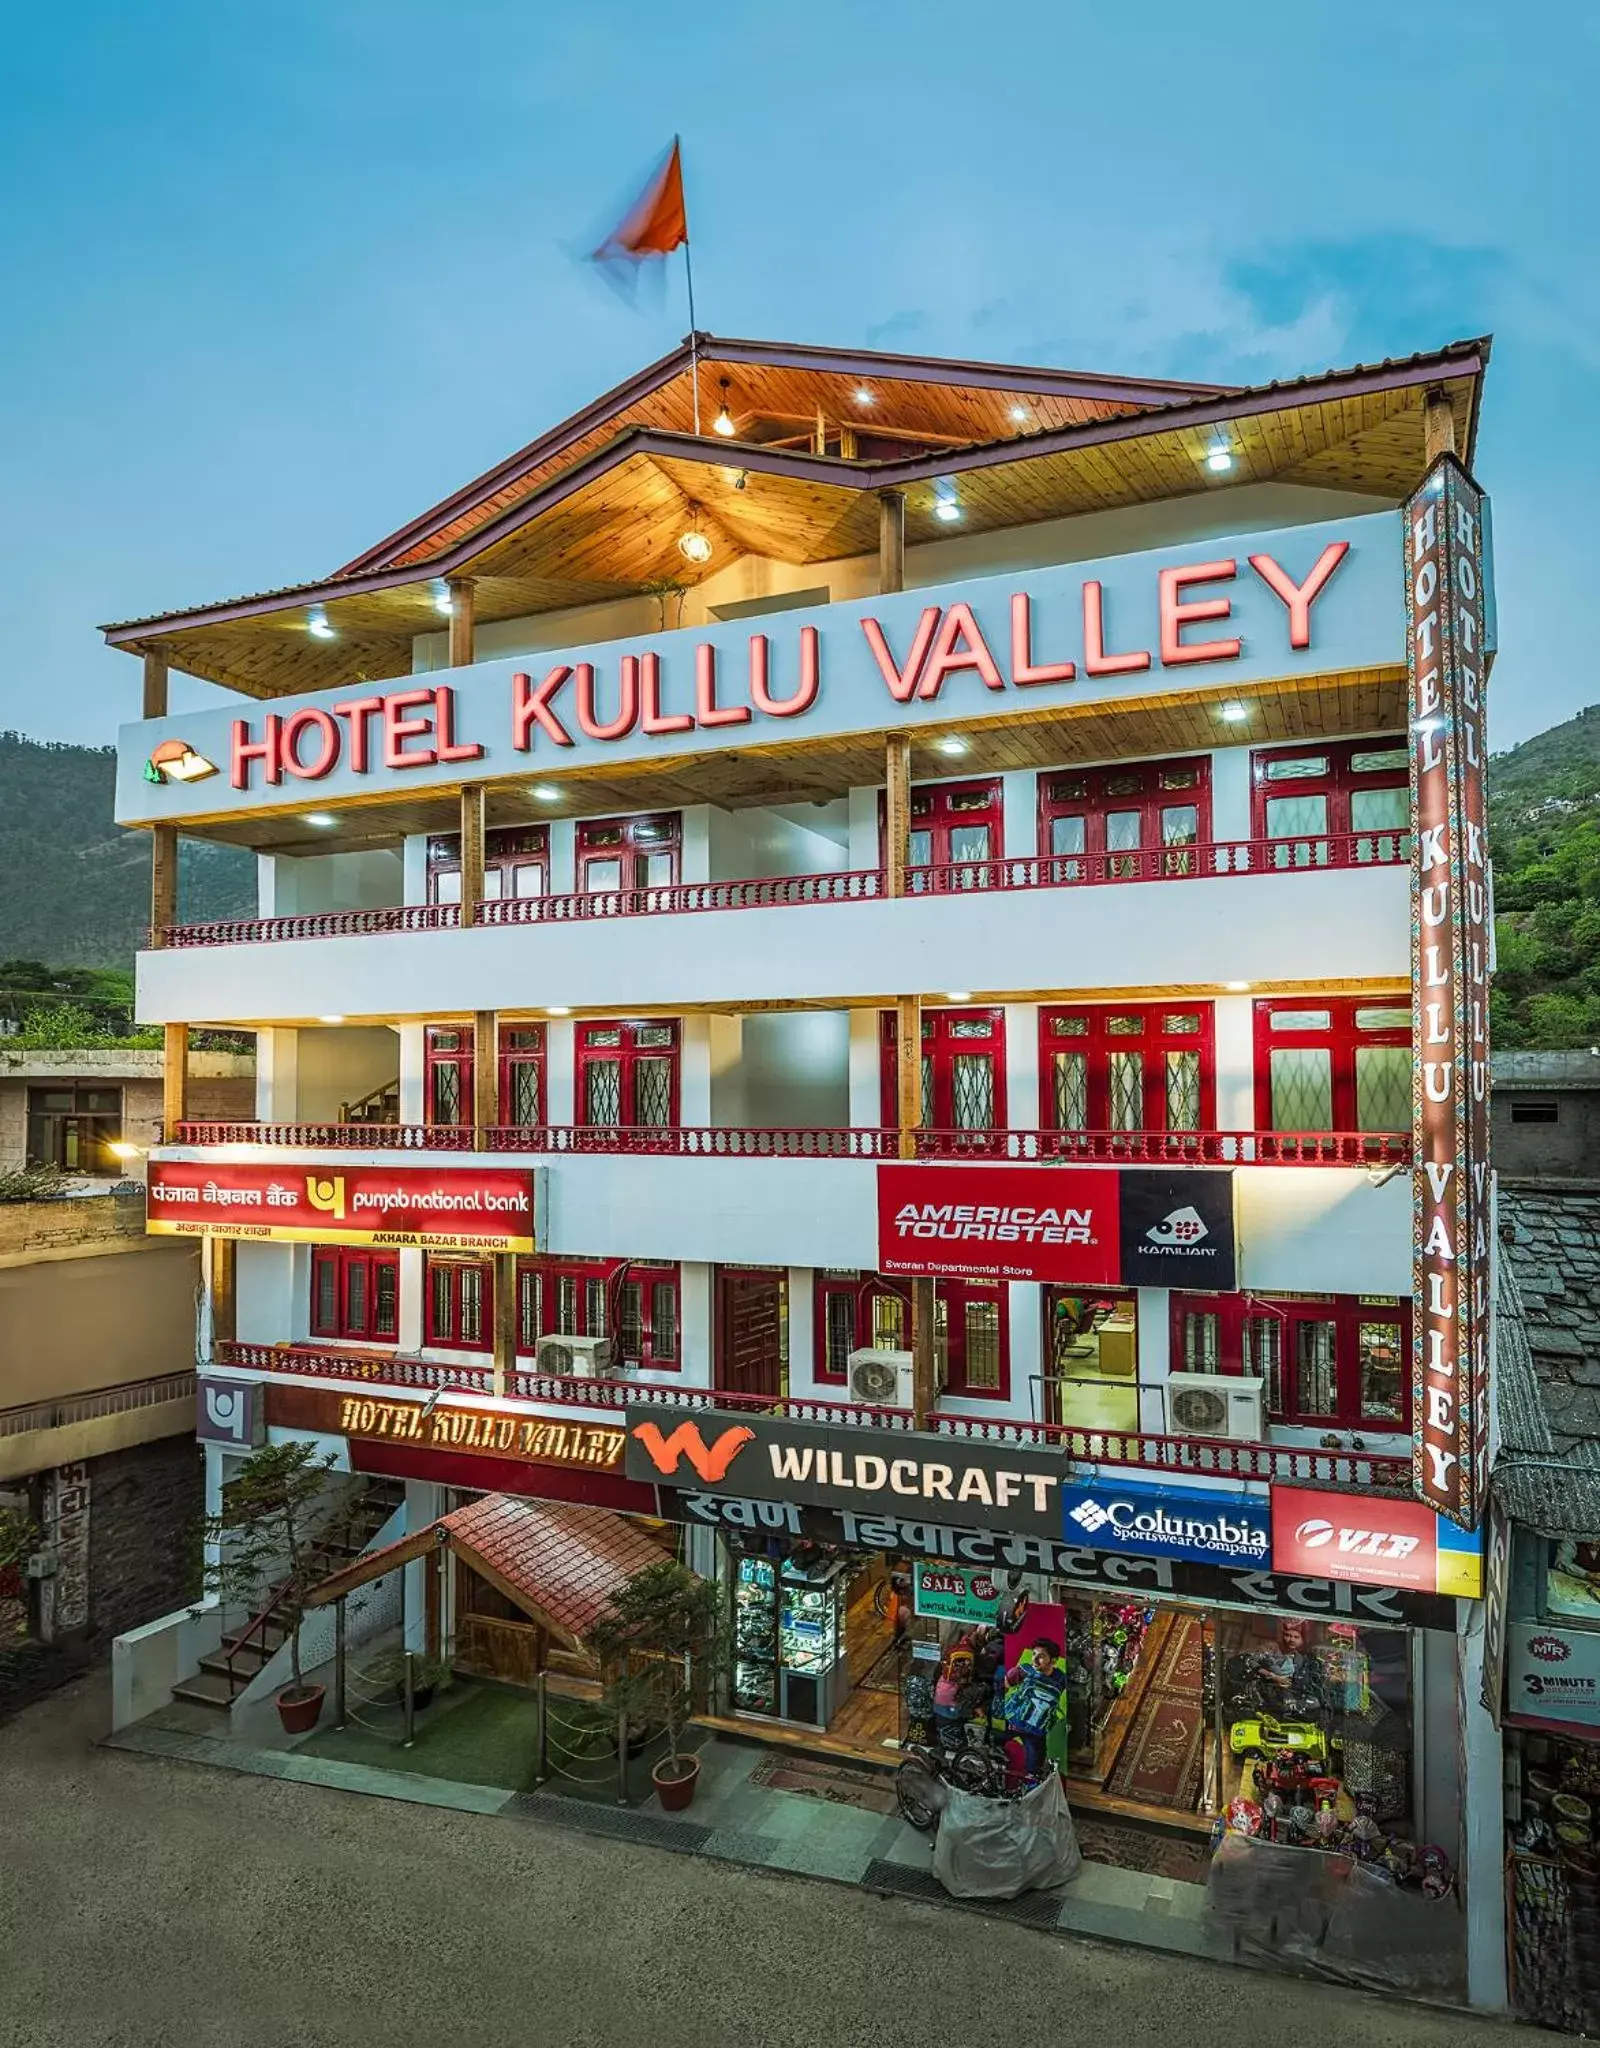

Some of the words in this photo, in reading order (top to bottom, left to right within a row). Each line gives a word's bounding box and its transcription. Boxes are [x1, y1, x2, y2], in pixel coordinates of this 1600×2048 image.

[1414, 504, 1442, 773] HOTEL
[1456, 501, 1480, 771] HOTEL
[230, 686, 484, 790] HOTEL
[512, 626, 819, 753] KULLU
[860, 541, 1350, 703] VALLEY
[1420, 823, 1452, 1104] KULLU
[1467, 820, 1486, 1103] KULLU
[151, 1181, 199, 1203] पंजाब
[202, 1180, 262, 1206] नैशनल
[265, 1182, 299, 1207] बैंक
[353, 1188, 409, 1213] punjab
[411, 1189, 482, 1210] national
[484, 1190, 529, 1212] bank
[895, 1203, 1093, 1226] AMERICAN
[372, 1233, 418, 1245] AKHARA
[420, 1235, 458, 1246] BAZAR
[461, 1236, 509, 1248] BRANCH
[927, 1262, 999, 1275] Departmental
[1002, 1266, 1033, 1276] Store
[1423, 1161, 1457, 1492] VALLEY
[341, 1398, 424, 1438] HOTEL
[768, 1443, 1058, 1513] WILDCRAFT
[1106, 1501, 1269, 1548] Columbia
[1112, 1526, 1193, 1548] Sportswear
[1194, 1535, 1267, 1560] Company
[922, 1576, 966, 1595] SALE
[976, 1587, 994, 1597] OFF
[1533, 1642, 1564, 1657] MTR
[1523, 1673, 1545, 1695] 3
[1543, 1676, 1596, 1688] MINUTE
